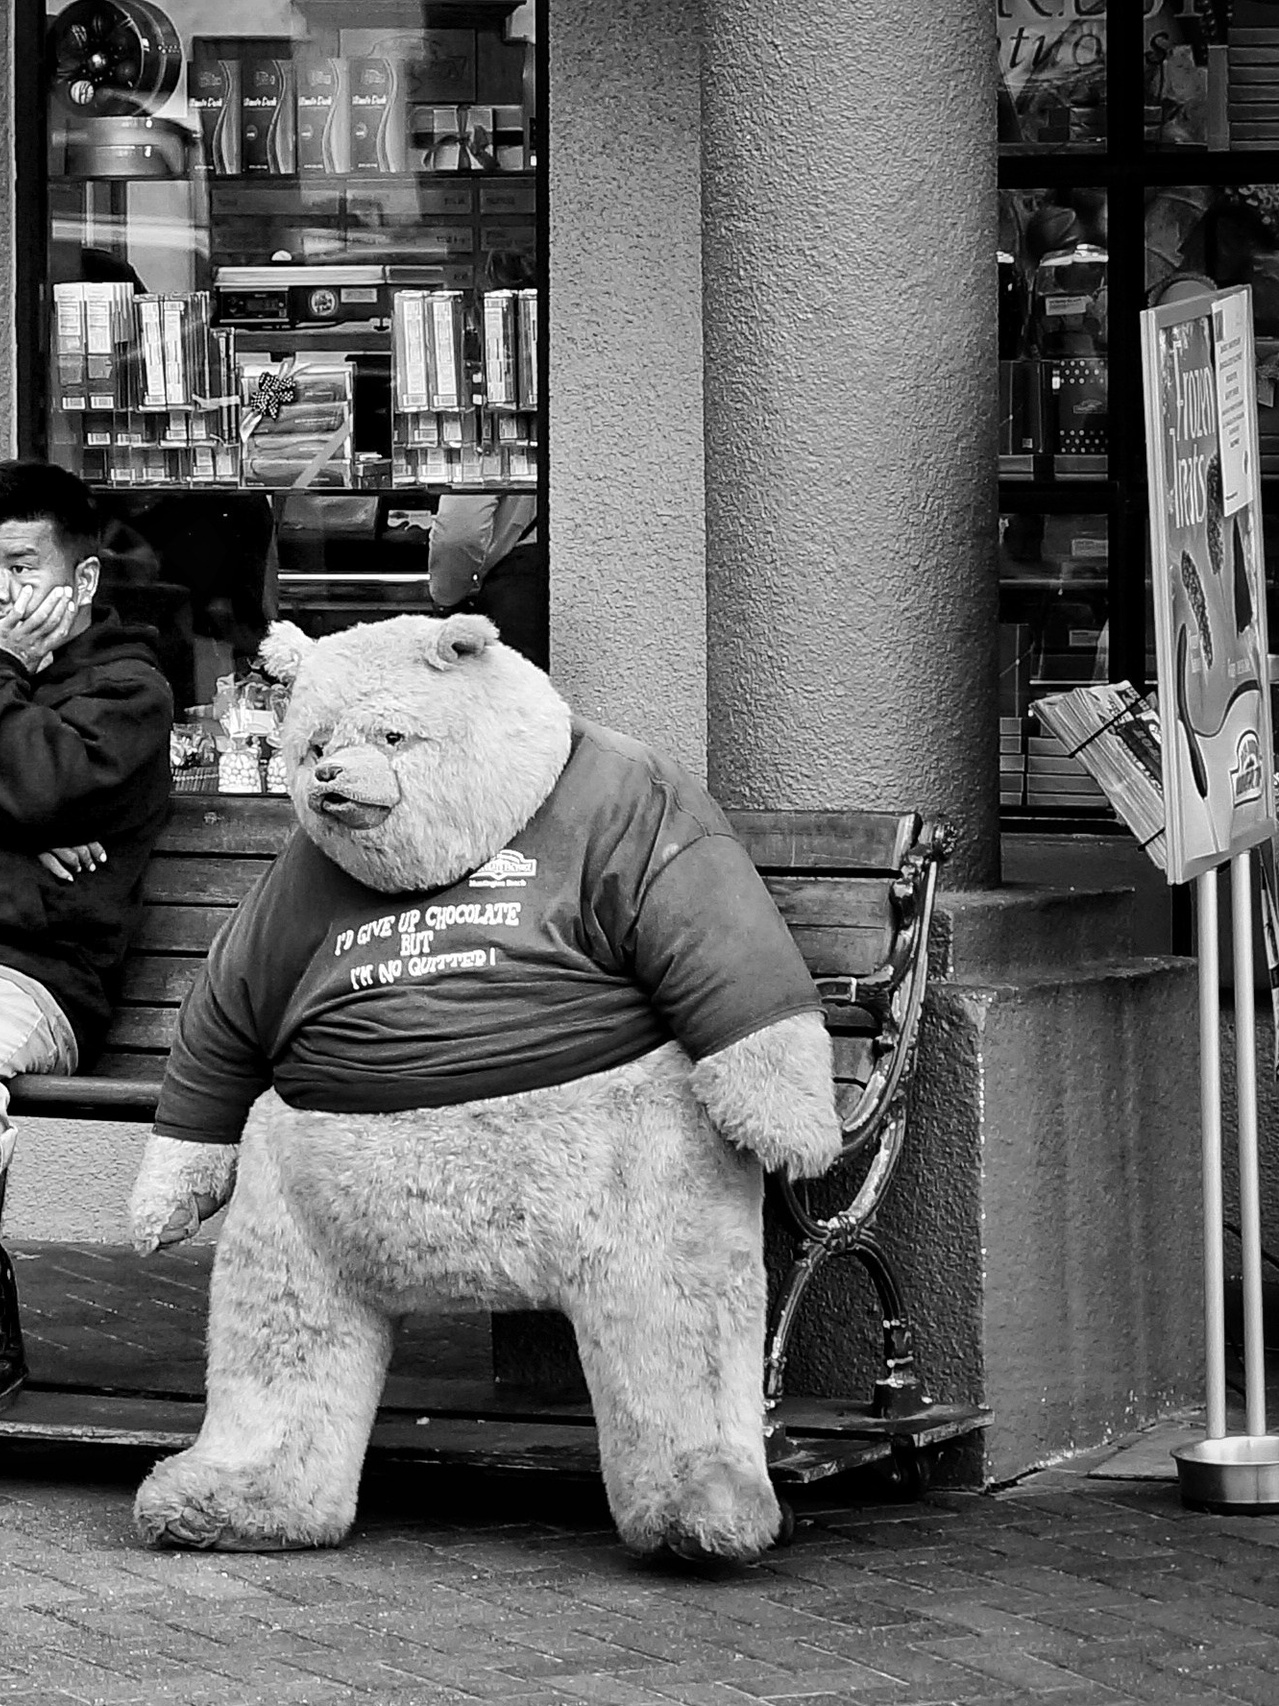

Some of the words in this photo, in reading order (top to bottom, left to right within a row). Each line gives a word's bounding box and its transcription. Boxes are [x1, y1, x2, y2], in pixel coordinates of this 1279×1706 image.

[334, 929, 355, 957] I'D
[357, 915, 397, 945] GIVE
[398, 909, 421, 934] UP
[425, 902, 522, 930] CHOCOLATE
[400, 930, 434, 957] BUT
[350, 964, 375, 991] I'M
[378, 959, 403, 984] NO
